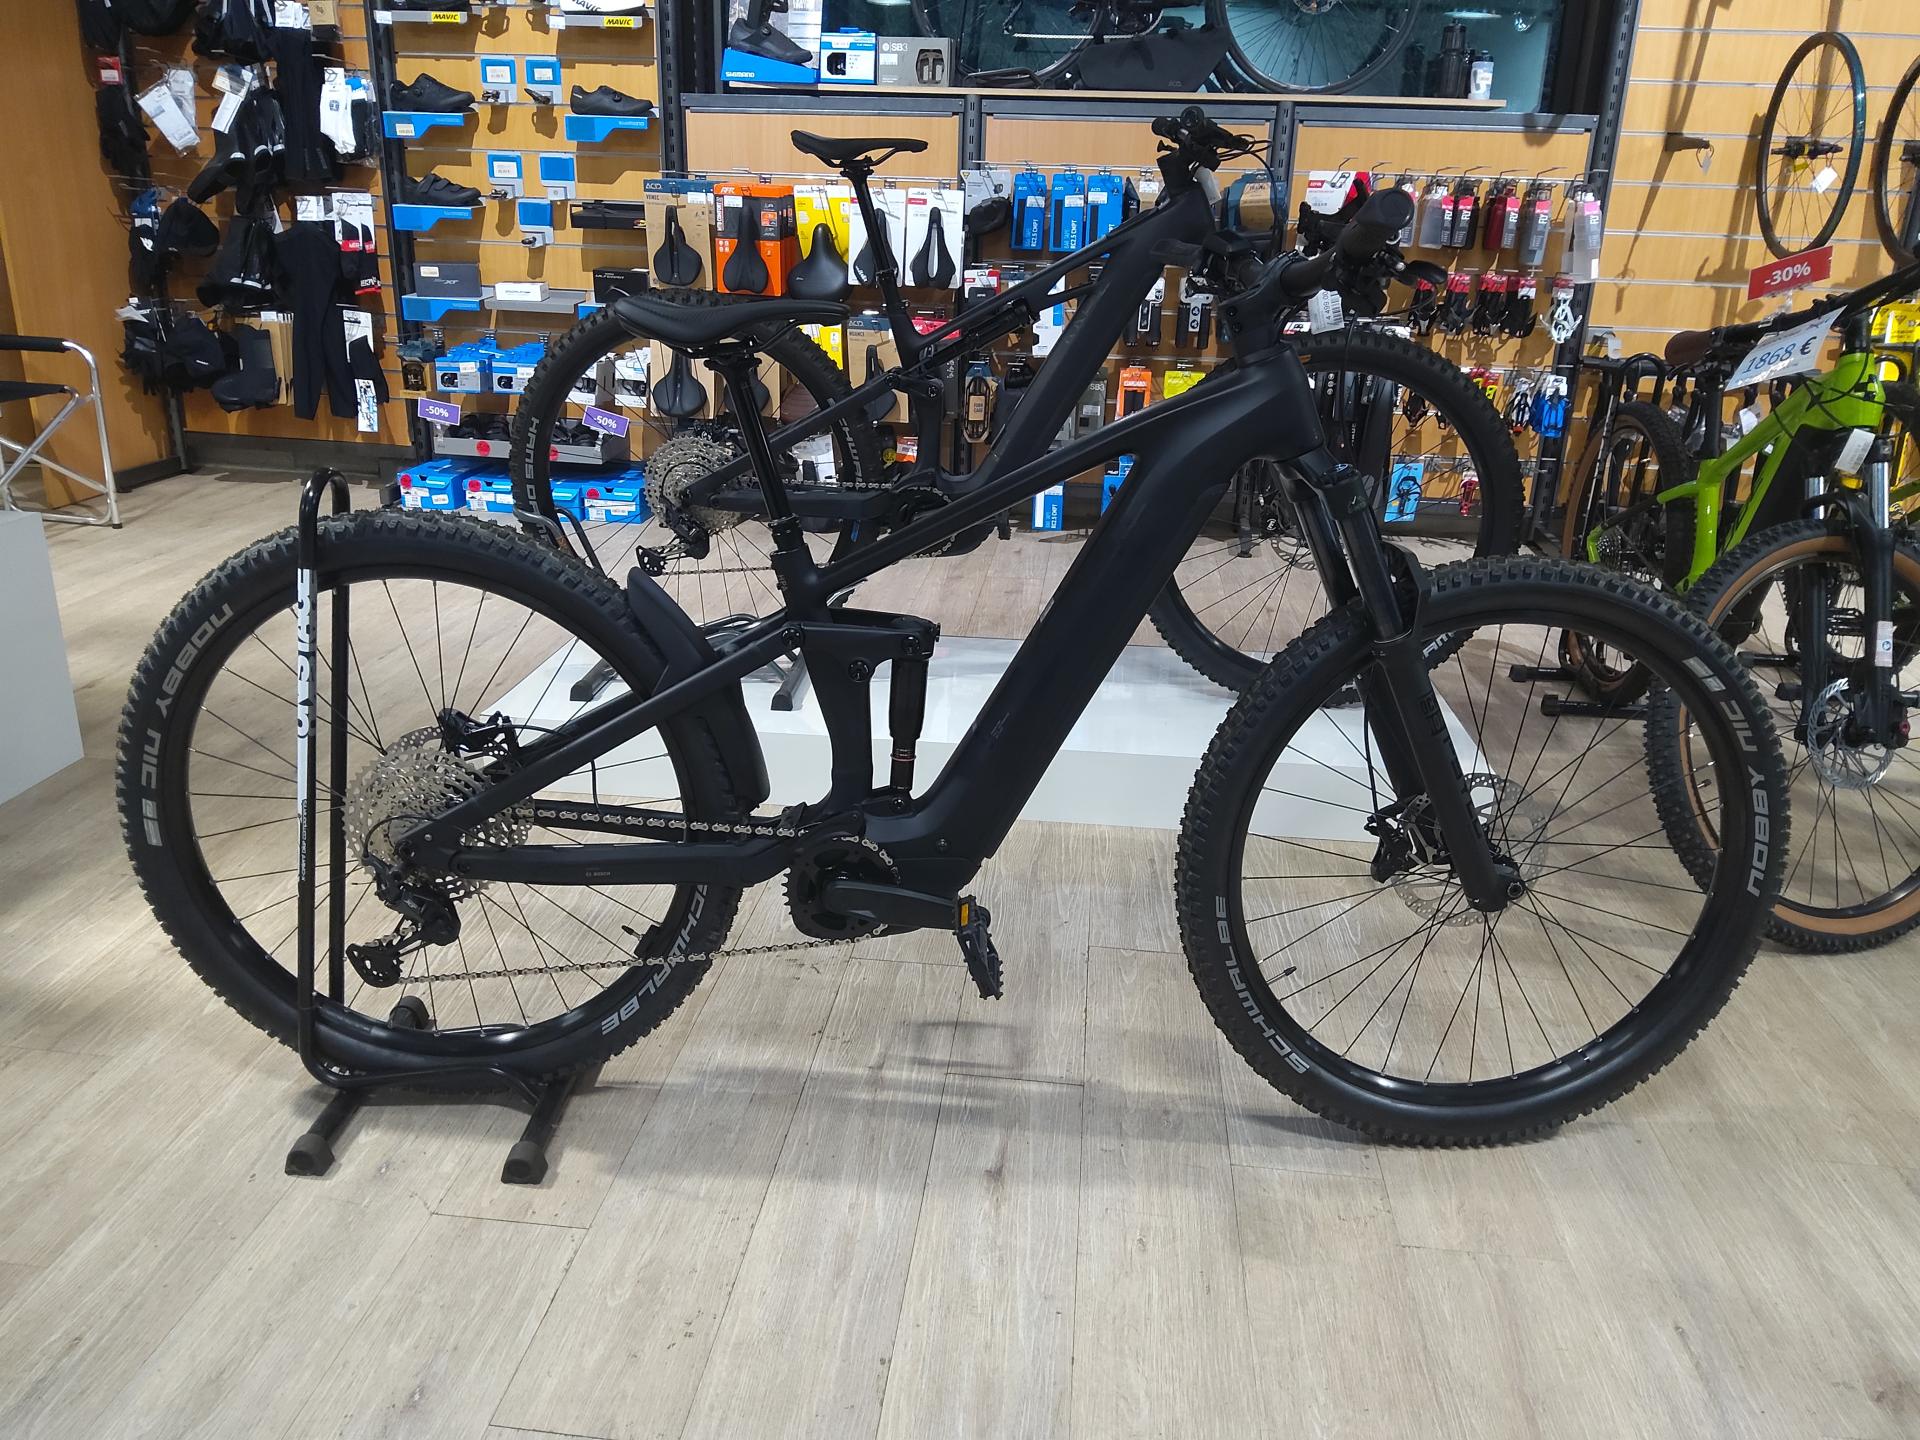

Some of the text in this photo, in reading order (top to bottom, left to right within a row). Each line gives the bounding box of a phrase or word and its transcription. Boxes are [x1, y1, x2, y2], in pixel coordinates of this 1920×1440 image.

[433, 13, 458, 21] MAVIC
[606, 18, 632, 26] MAVIC
[1444, 210, 1453, 219] FLY
[1461, 210, 1471, 220] FLY
[1509, 211, 1519, 222] FLY
[1538, 215, 1548, 224] FLY
[1589, 215, 1599, 224] FLY
[1764, 262, 1811, 286] -30%
[1742, 336, 1818, 374] 1868 €
[425, 406, 449, 418] -50%
[593, 414, 617, 429] -50%
[525, 416, 540, 479] HANS
[155, 602, 234, 720] NOBBY
[141, 727, 161, 786] NIC
[1719, 699, 1770, 897] NOBBY NIC
[601, 890, 708, 1035] CHWALBE
[1215, 895, 1310, 1075] SCHWALBE
